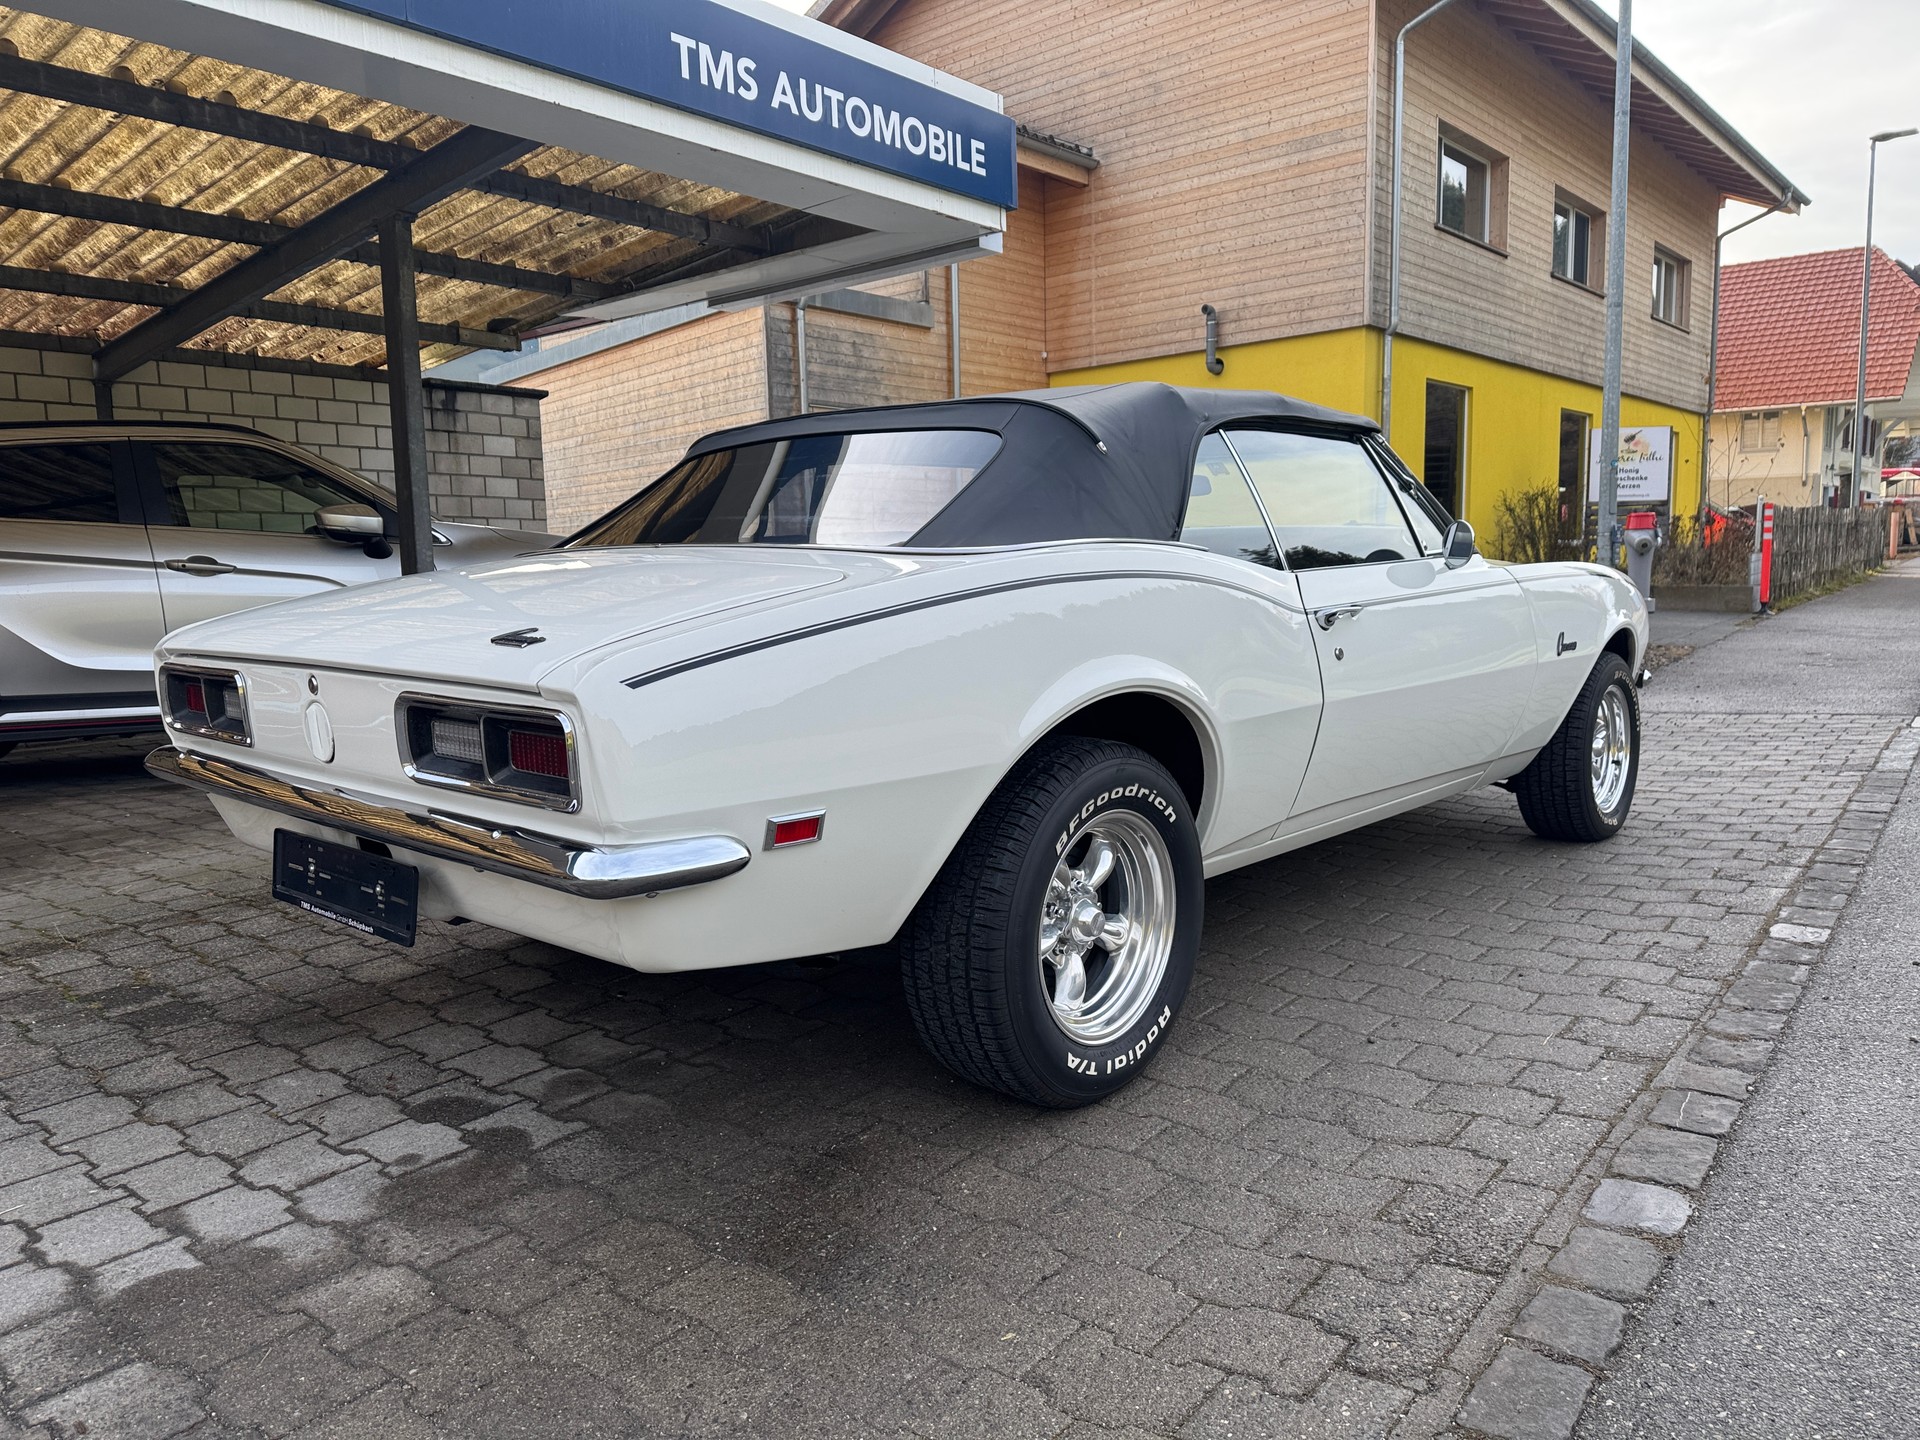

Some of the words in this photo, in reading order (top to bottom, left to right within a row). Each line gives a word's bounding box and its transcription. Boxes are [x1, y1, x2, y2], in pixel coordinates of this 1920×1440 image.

[670, 31, 759, 101] TMS
[770, 70, 987, 177] AUTOMOBILE
[1619, 467, 1640, 475] Honig
[1055, 783, 1177, 856] BFGoodrich
[301, 901, 311, 910] TMS
[311, 905, 336, 920] Automobile
[348, 918, 374, 933] Schüpbach
[1066, 1051, 1098, 1076] T/A
[1106, 1005, 1172, 1075] Radial
